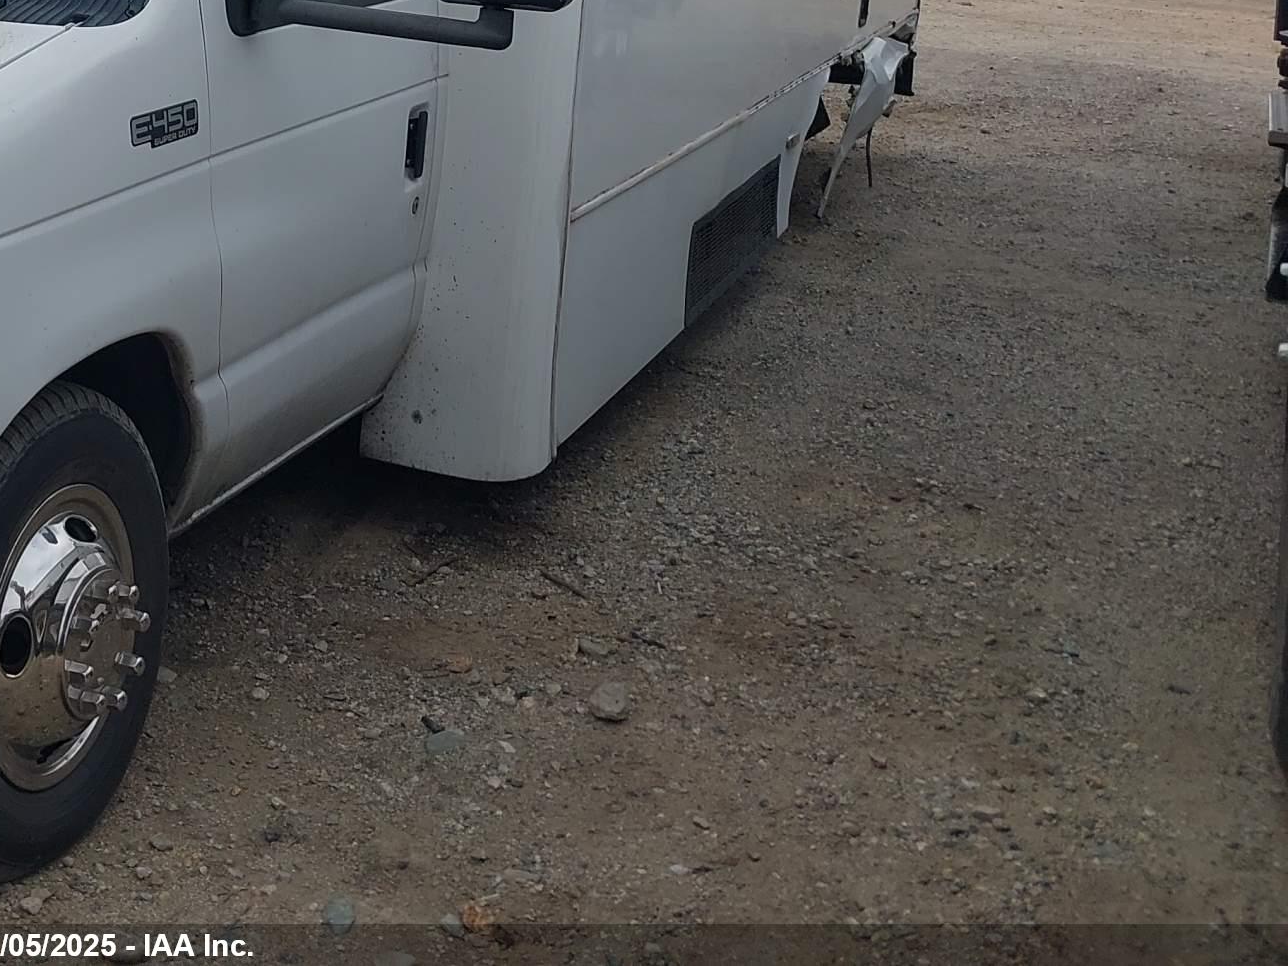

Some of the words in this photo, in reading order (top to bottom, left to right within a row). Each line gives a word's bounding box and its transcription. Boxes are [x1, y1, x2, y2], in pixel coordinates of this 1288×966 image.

[132, 100, 198, 145] E-450
[153, 132, 177, 147] SUPER
[178, 126, 198, 139] DUTY
